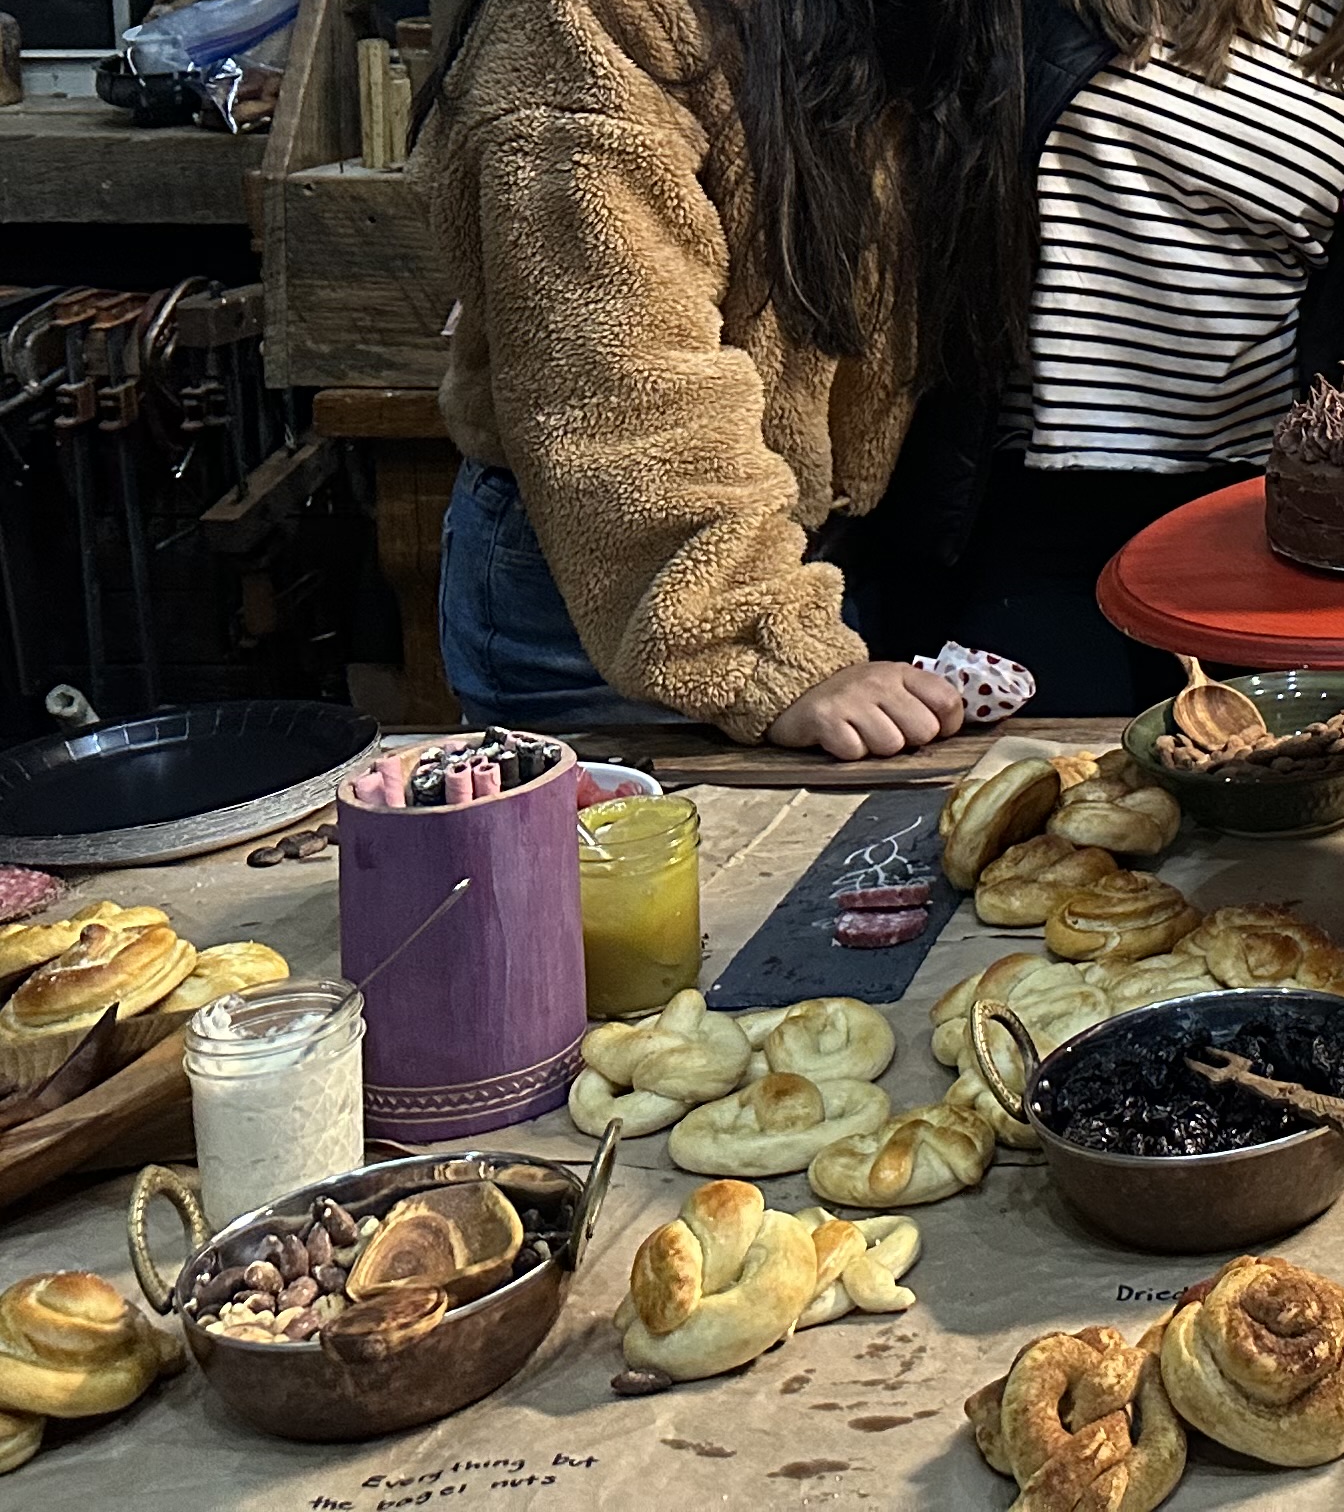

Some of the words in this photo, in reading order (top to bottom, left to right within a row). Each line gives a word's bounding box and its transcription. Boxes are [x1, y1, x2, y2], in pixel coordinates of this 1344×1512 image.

[1116, 1282, 1186, 1304] Dried
[360, 1453, 527, 1490] Everything
[550, 1451, 600, 1470] but
[308, 1494, 357, 1512] the
[490, 1471, 559, 1490] nuts
